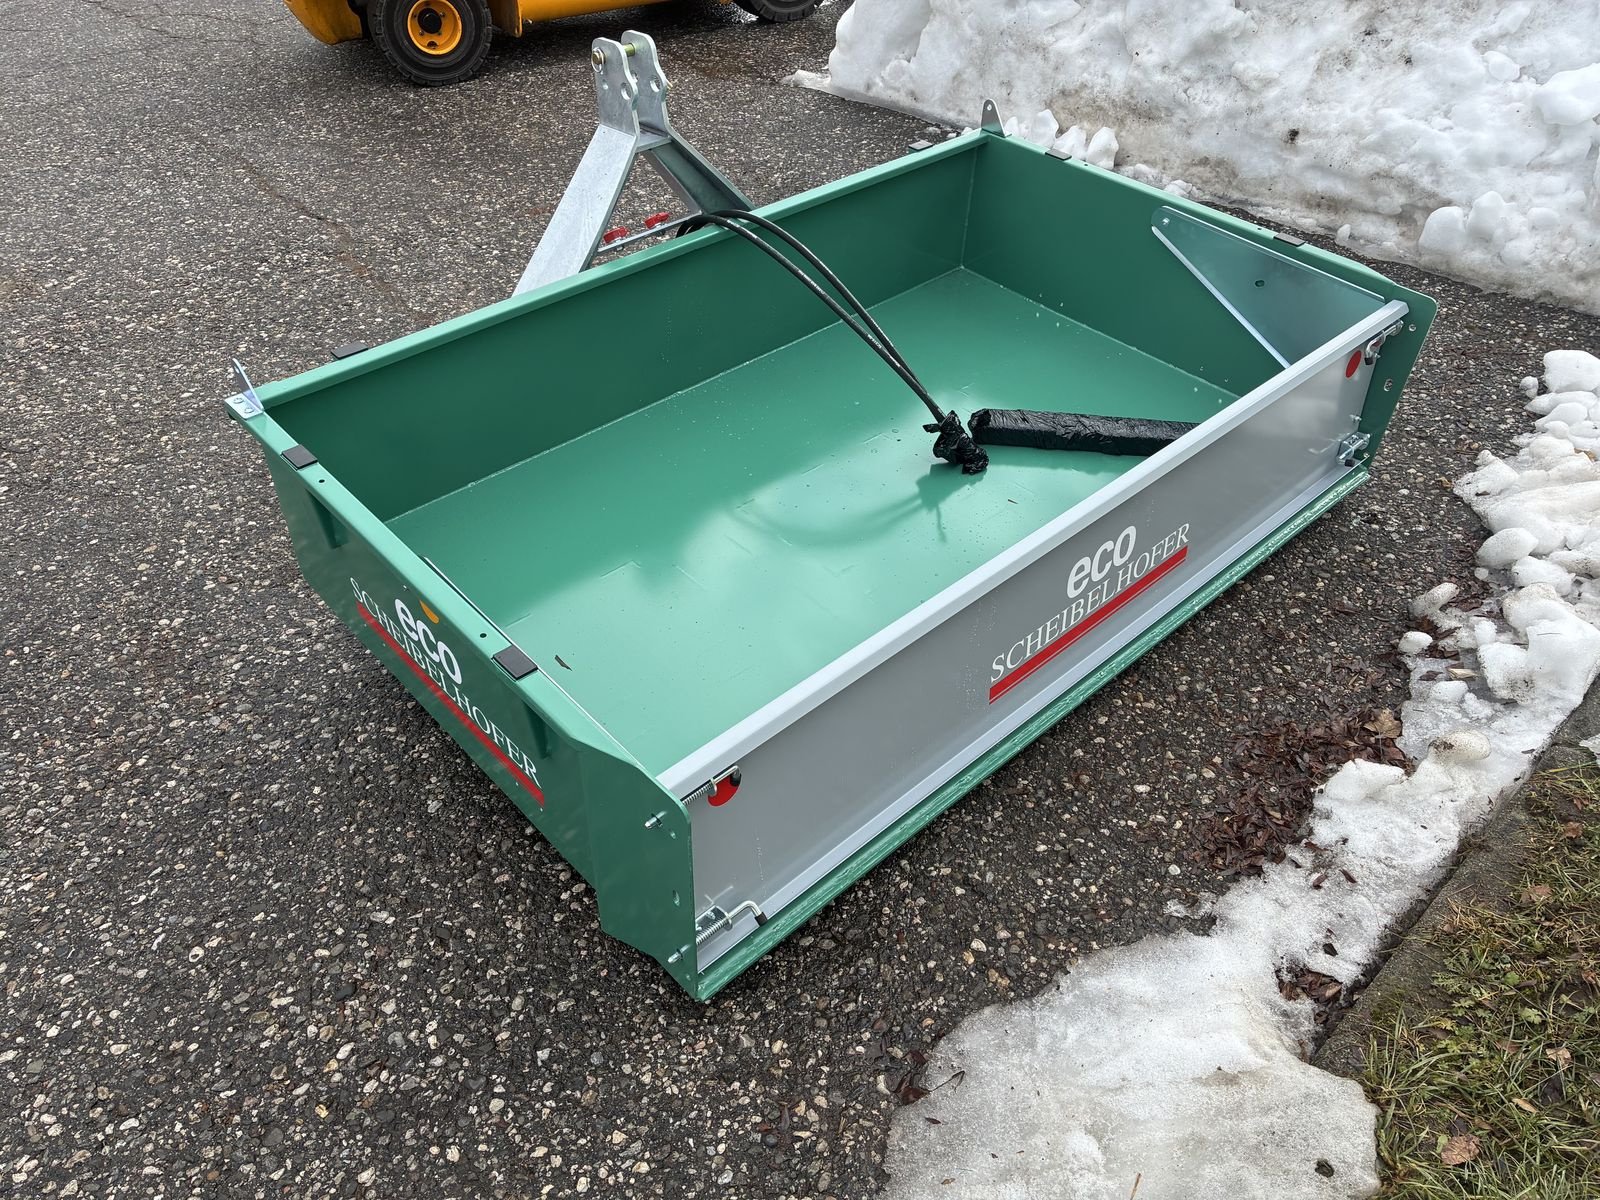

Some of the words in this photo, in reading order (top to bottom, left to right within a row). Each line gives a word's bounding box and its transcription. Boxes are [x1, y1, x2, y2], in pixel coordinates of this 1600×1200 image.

[990, 523, 1190, 683] SCHEIBELHOFER
[1067, 525, 1137, 599] eco
[350, 577, 542, 789] SCHEIBELHOFER
[394, 598, 463, 685] eco
